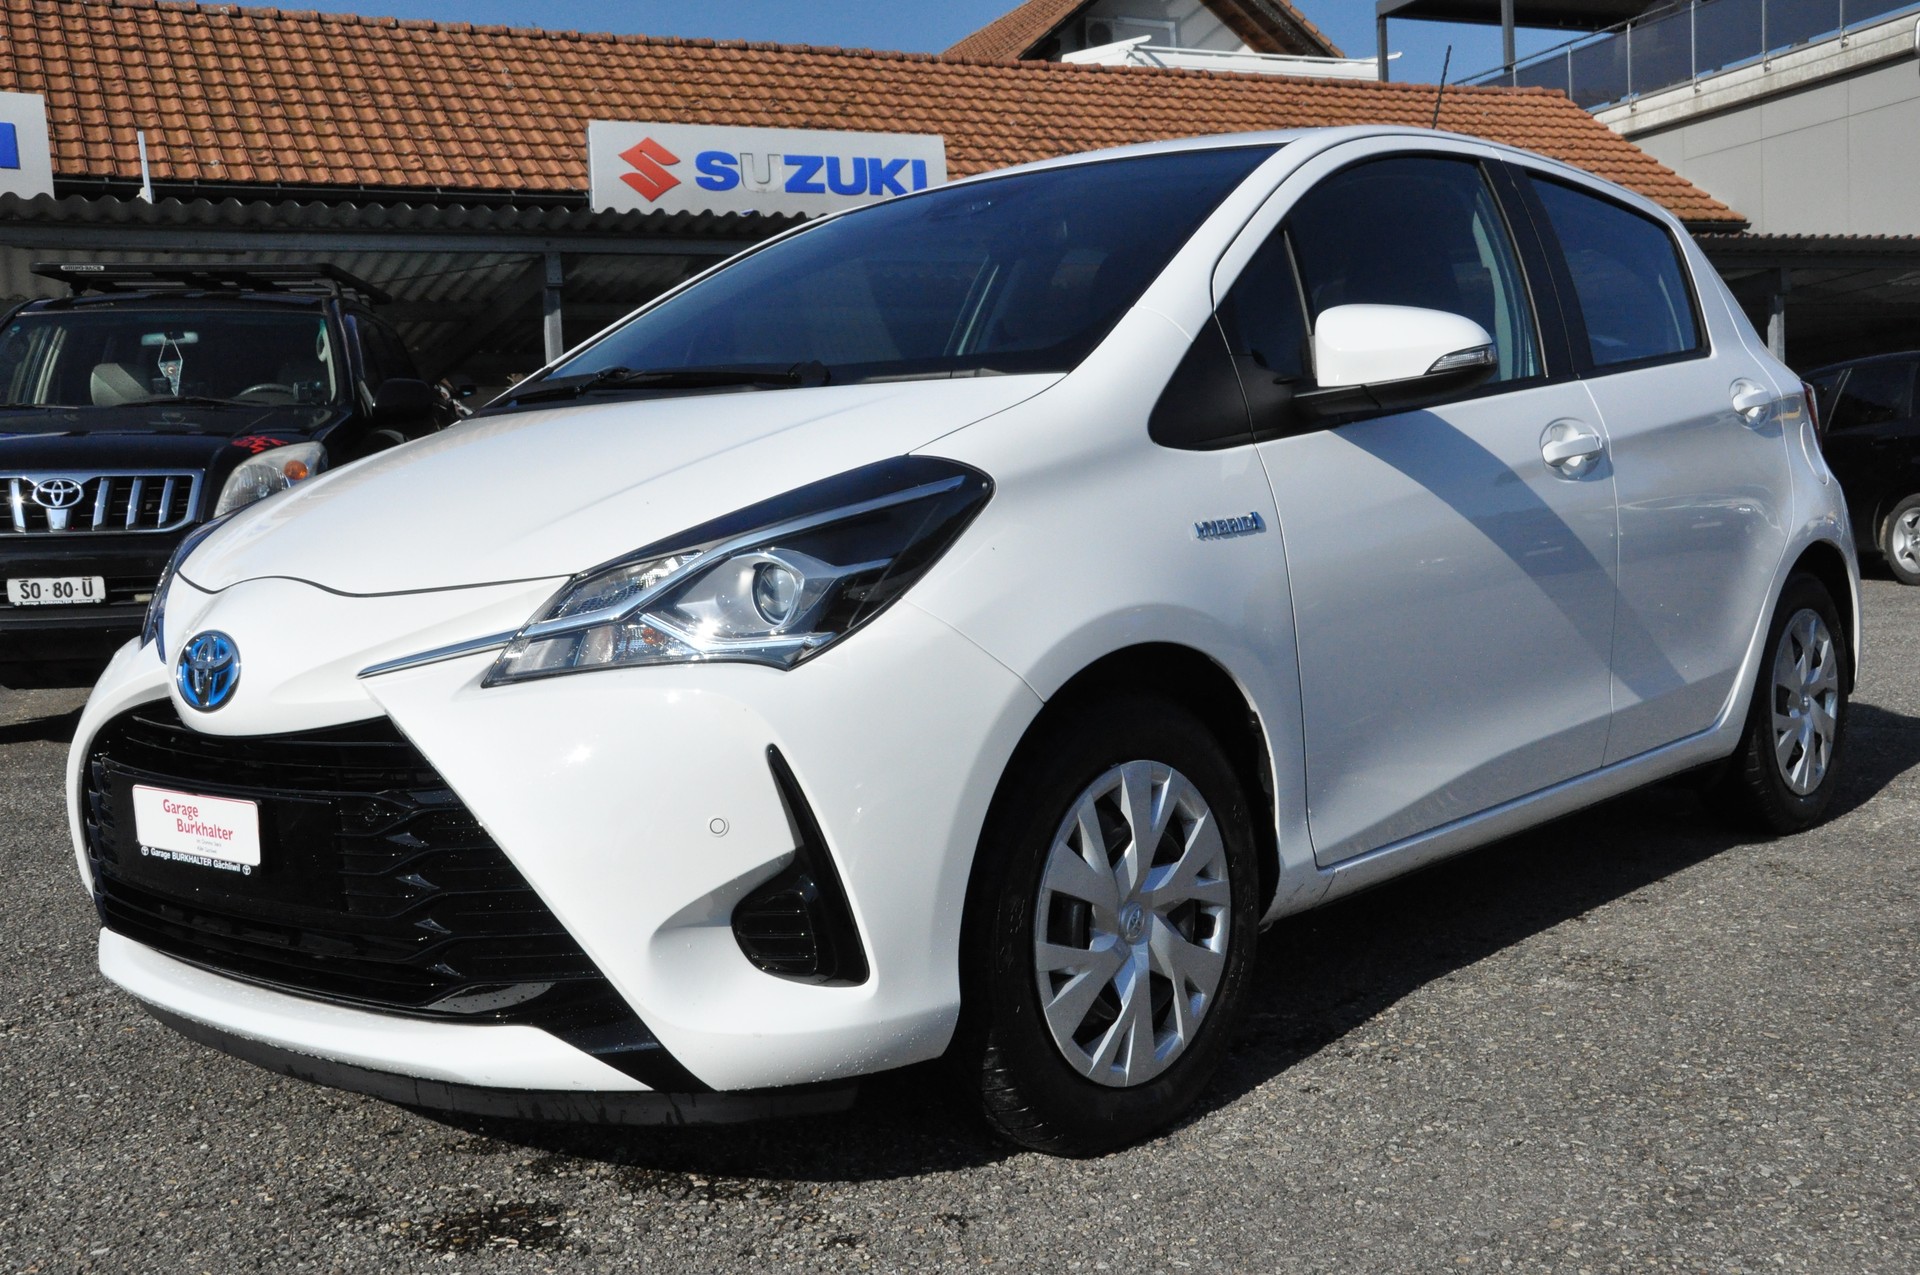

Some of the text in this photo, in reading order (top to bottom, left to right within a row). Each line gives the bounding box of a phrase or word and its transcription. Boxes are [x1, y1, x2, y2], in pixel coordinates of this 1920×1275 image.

[695, 151, 928, 196] SUZUKI
[1193, 514, 1256, 538] HYBRID
[162, 799, 199, 820] Garage
[176, 818, 233, 840] Burkhalter
[150, 847, 171, 860] Garage
[171, 851, 212, 867] BURKHALTER
